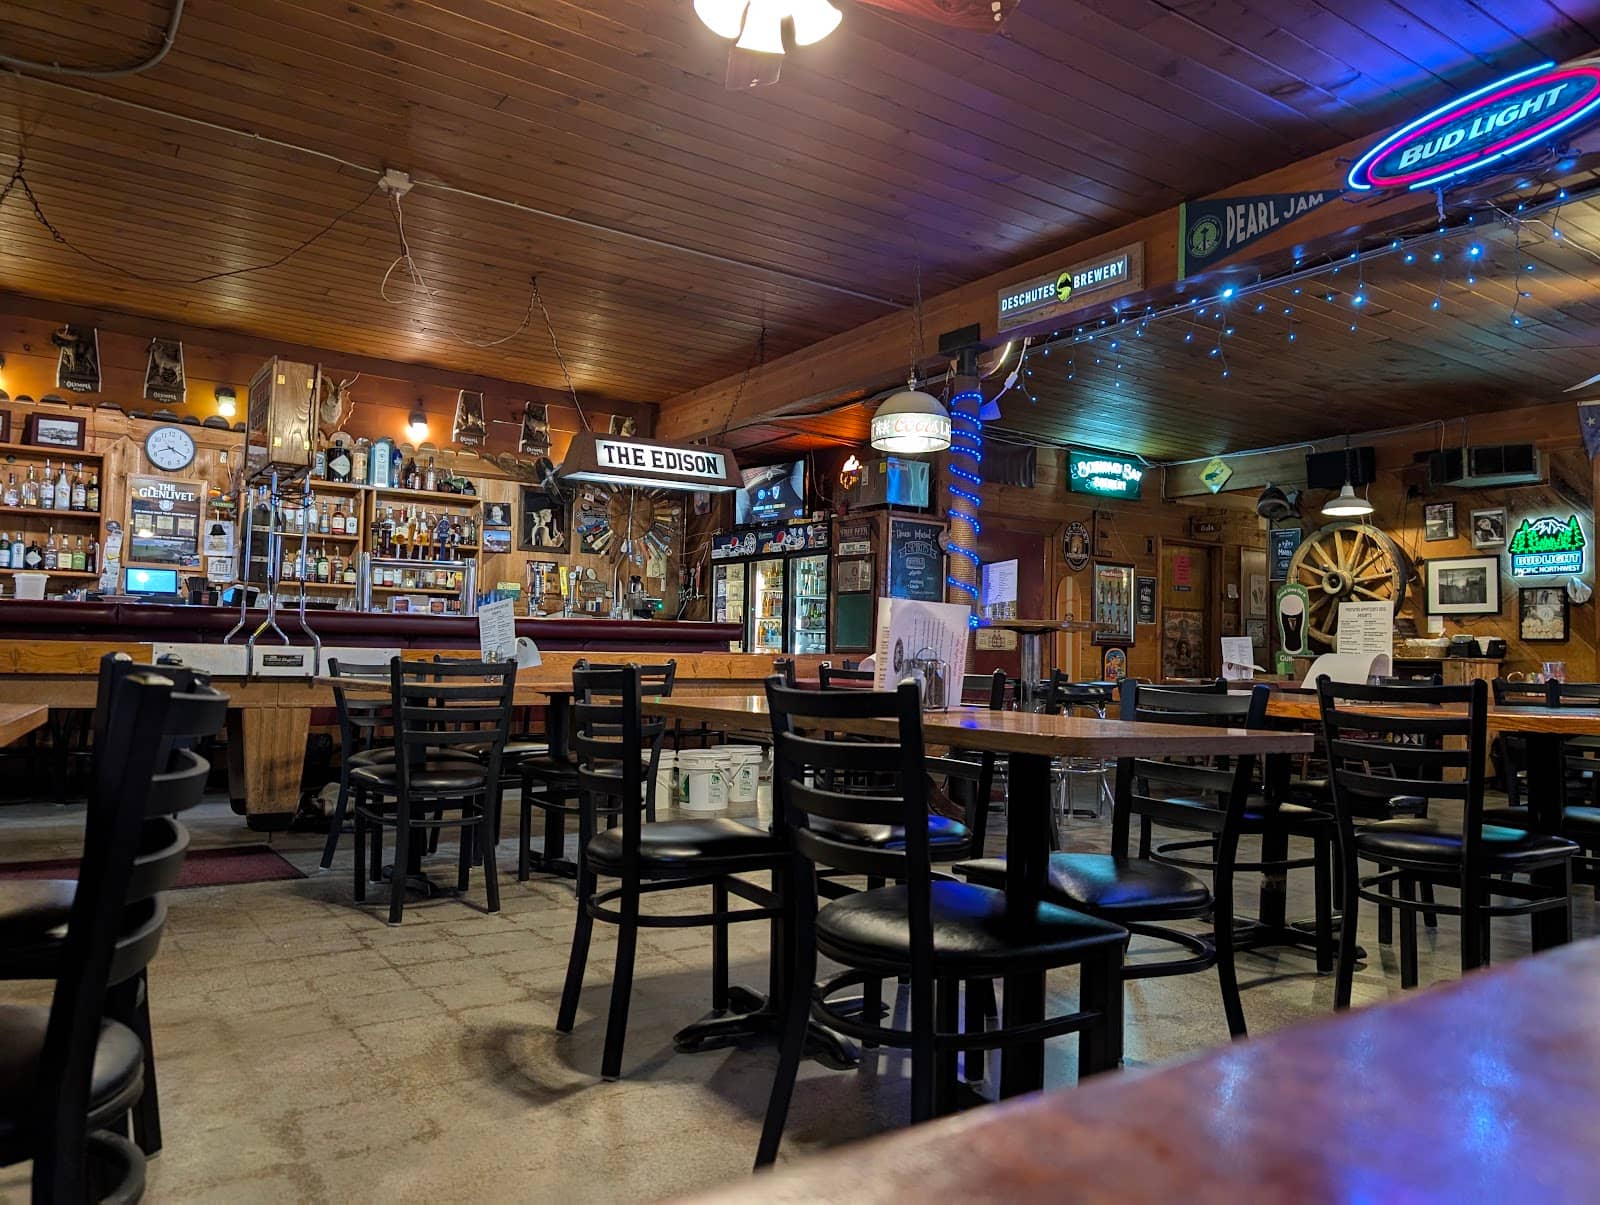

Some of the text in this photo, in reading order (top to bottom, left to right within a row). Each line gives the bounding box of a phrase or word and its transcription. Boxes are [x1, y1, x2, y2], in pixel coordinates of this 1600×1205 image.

[1398, 83, 1568, 170] BUD LIGHT
[1226, 201, 1279, 249] PEARL
[1283, 193, 1324, 219] JAM
[1001, 260, 1124, 312] DESCHUTES BREWERY
[603, 444, 719, 475] THE EDISON
[139, 487, 194, 502] GLENLIVET
[158, 483, 176, 492] THE
[1517, 553, 1579, 566] BUD LIGHT
[1539, 564, 1581, 573] NORTHWEST
